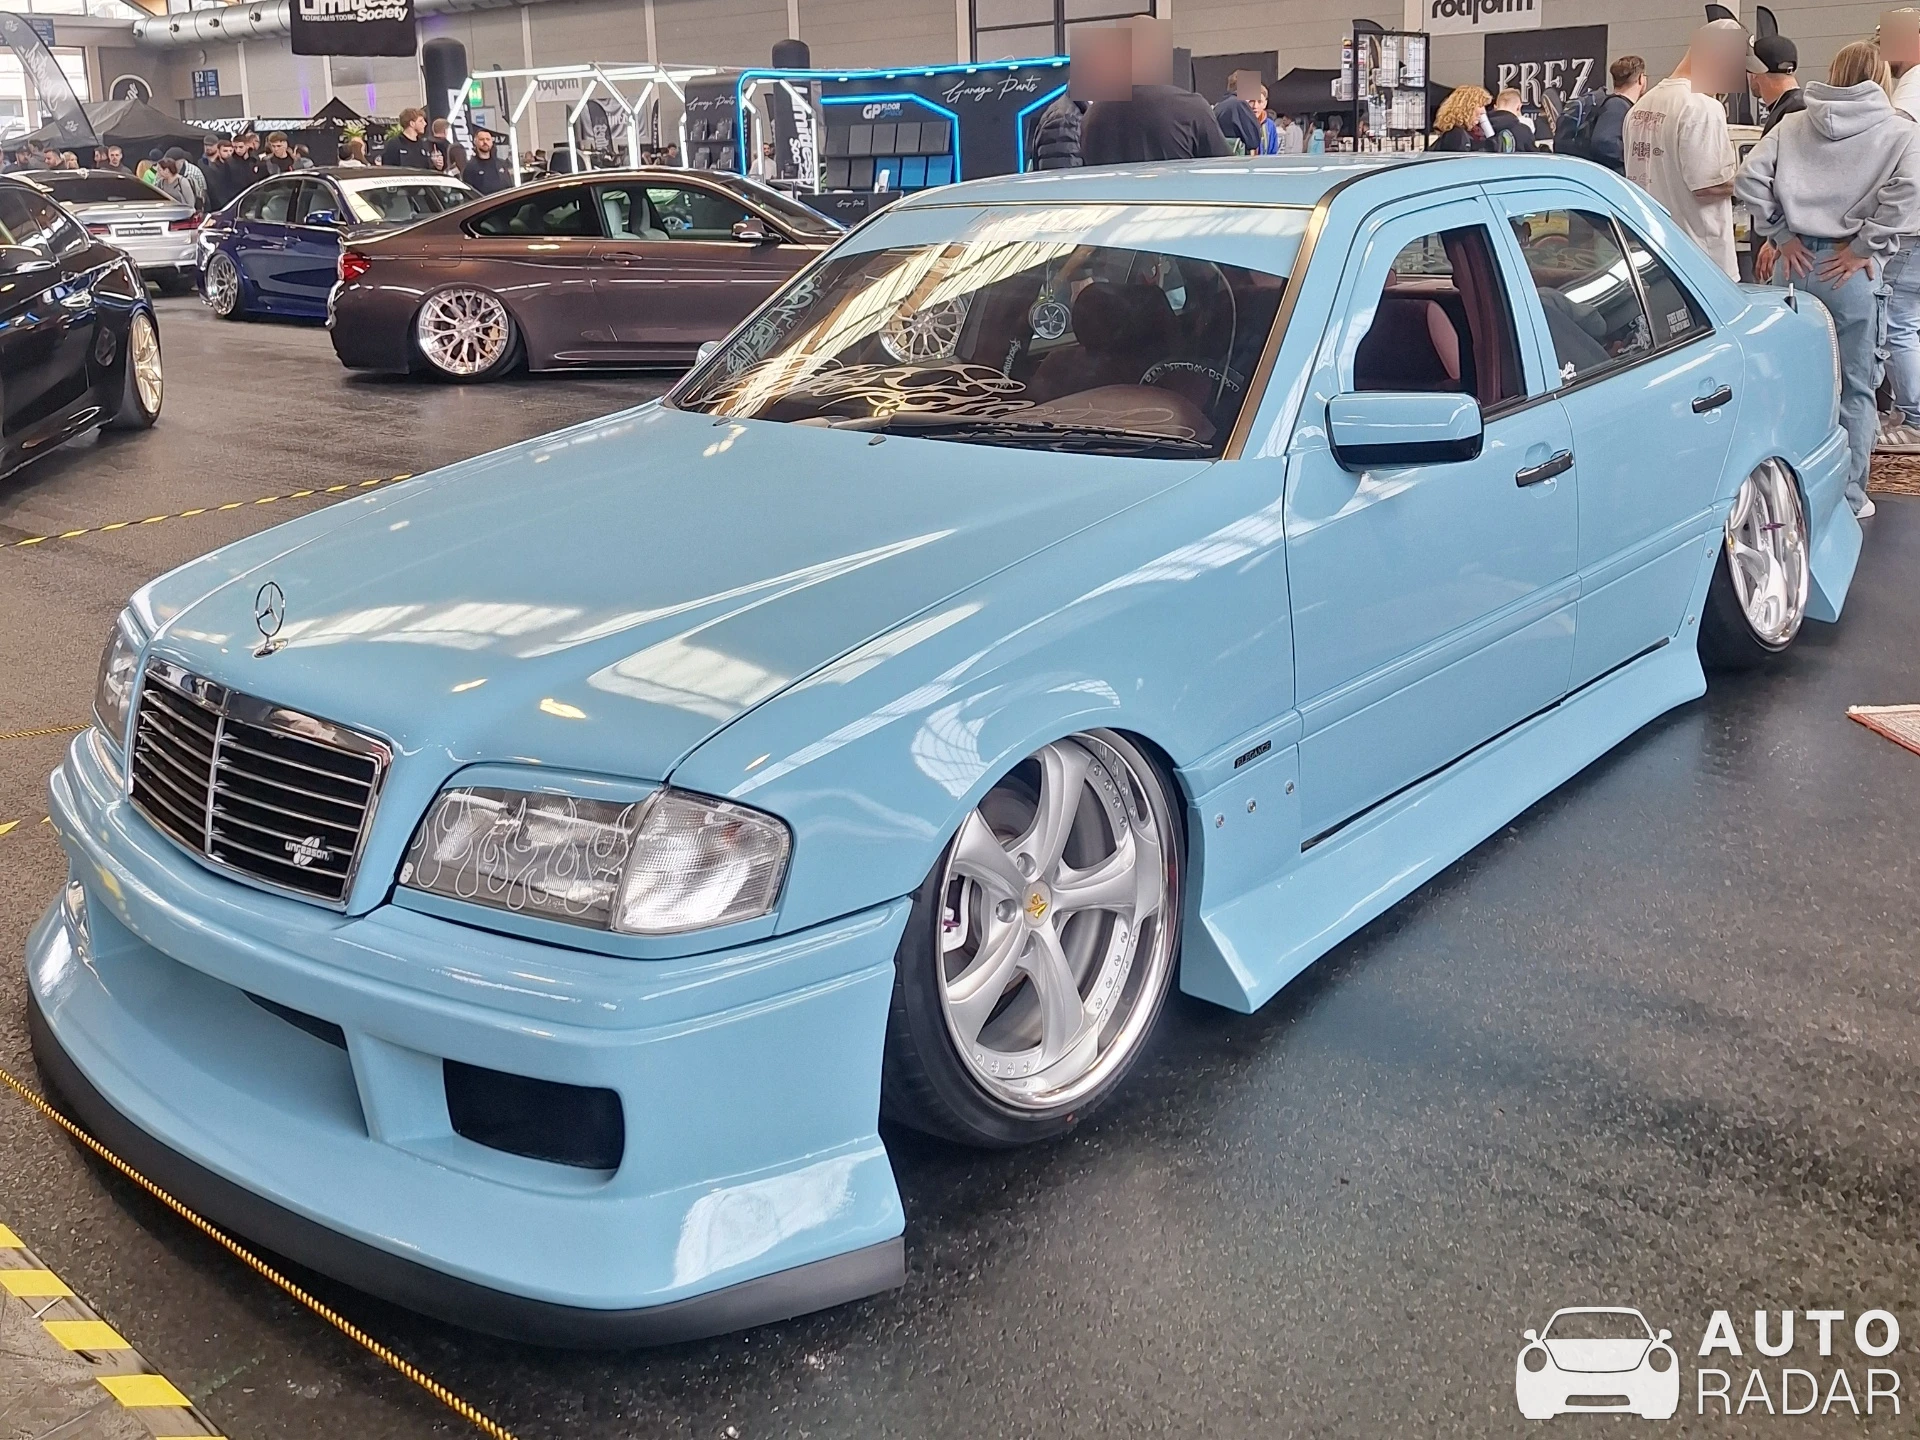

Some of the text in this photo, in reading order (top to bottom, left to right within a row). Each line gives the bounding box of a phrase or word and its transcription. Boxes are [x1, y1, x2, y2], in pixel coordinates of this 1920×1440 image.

[357, 5, 408, 22] Society
[942, 74, 1041, 103] Garage Parts
[1498, 58, 1595, 108] PREZ
[862, 103, 901, 119] GP FLOOR
